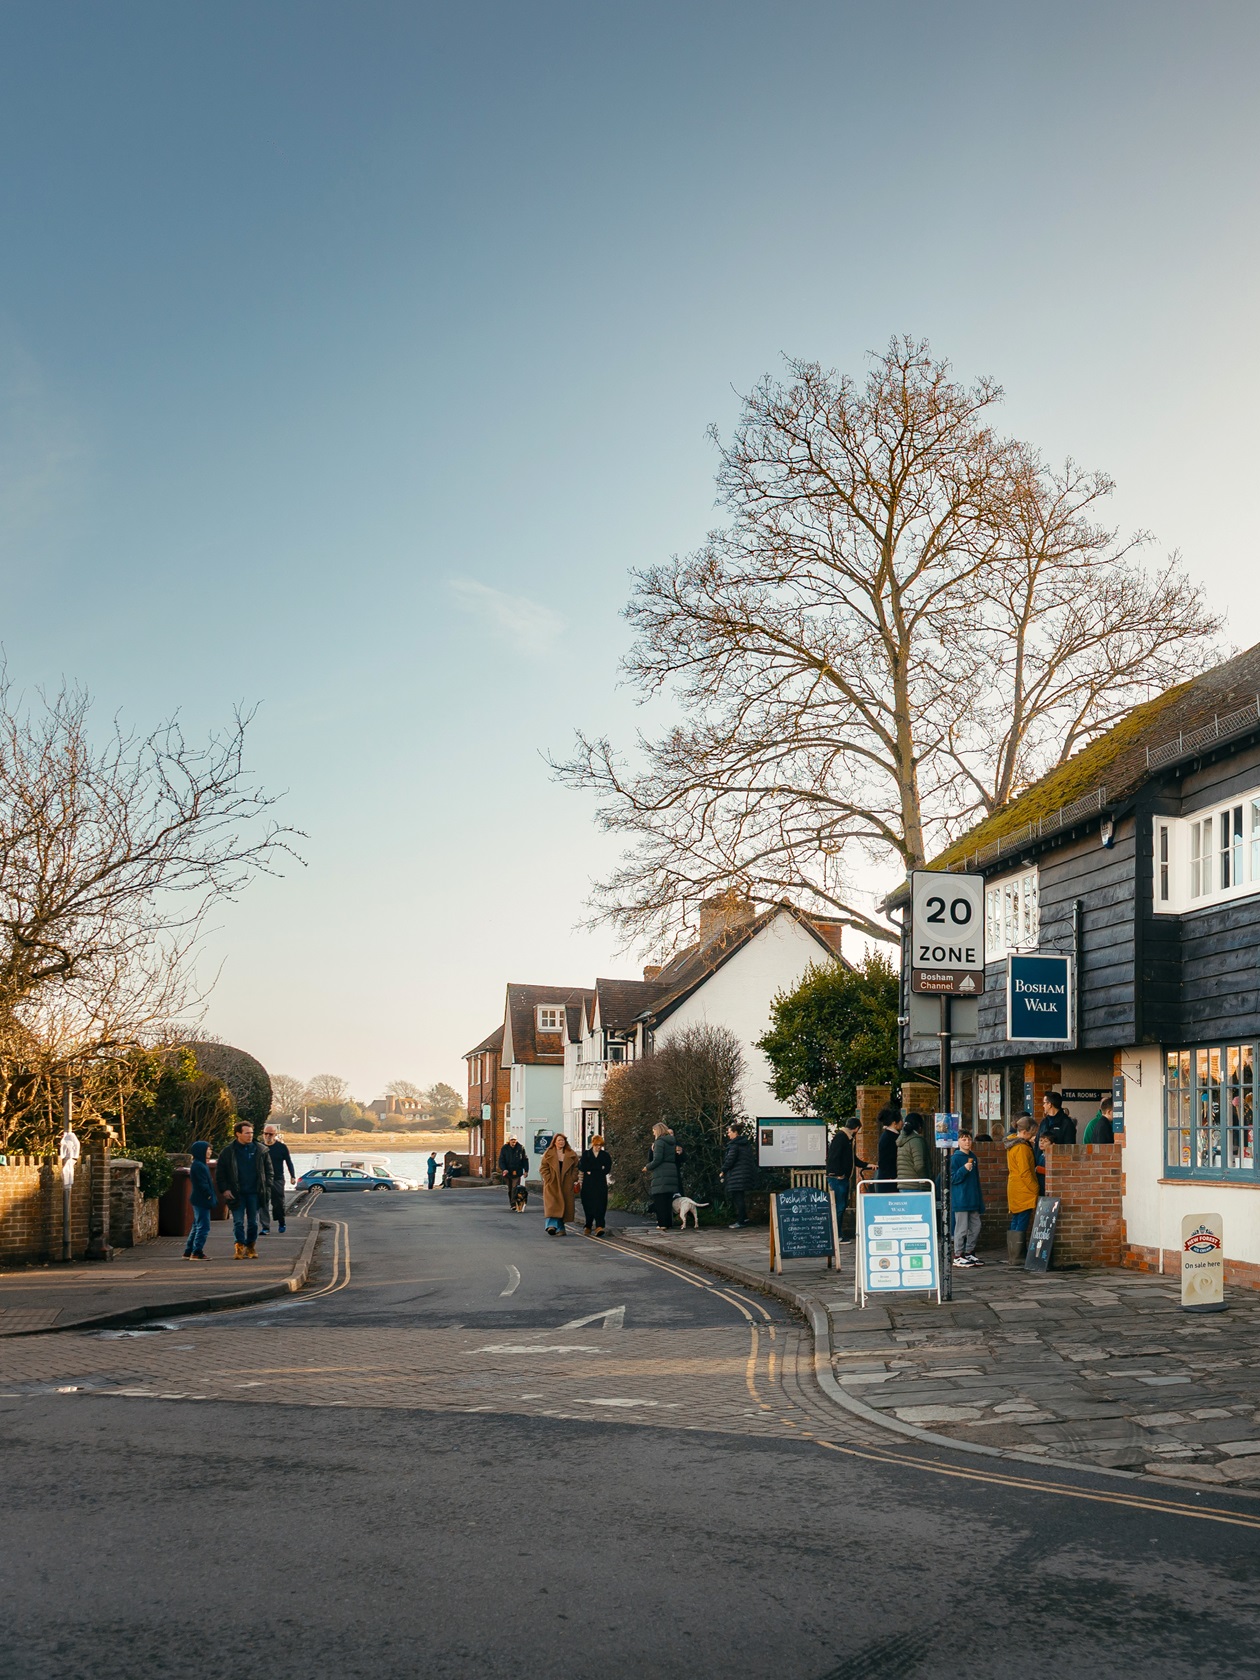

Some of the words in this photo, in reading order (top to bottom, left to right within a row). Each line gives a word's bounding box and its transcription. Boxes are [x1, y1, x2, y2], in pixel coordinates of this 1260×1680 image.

[926, 896, 972, 925] 20
[919, 946, 976, 963] ZONE
[920, 972, 954, 981] Bosham
[920, 981, 954, 990] Channel
[1015, 979, 1065, 994] BOSHAM
[1024, 998, 1058, 1012] WALK
[1186, 1237, 1199, 1246] NEW
[1199, 1235, 1219, 1244] FOREST
[1194, 1261, 1207, 1269] sale
